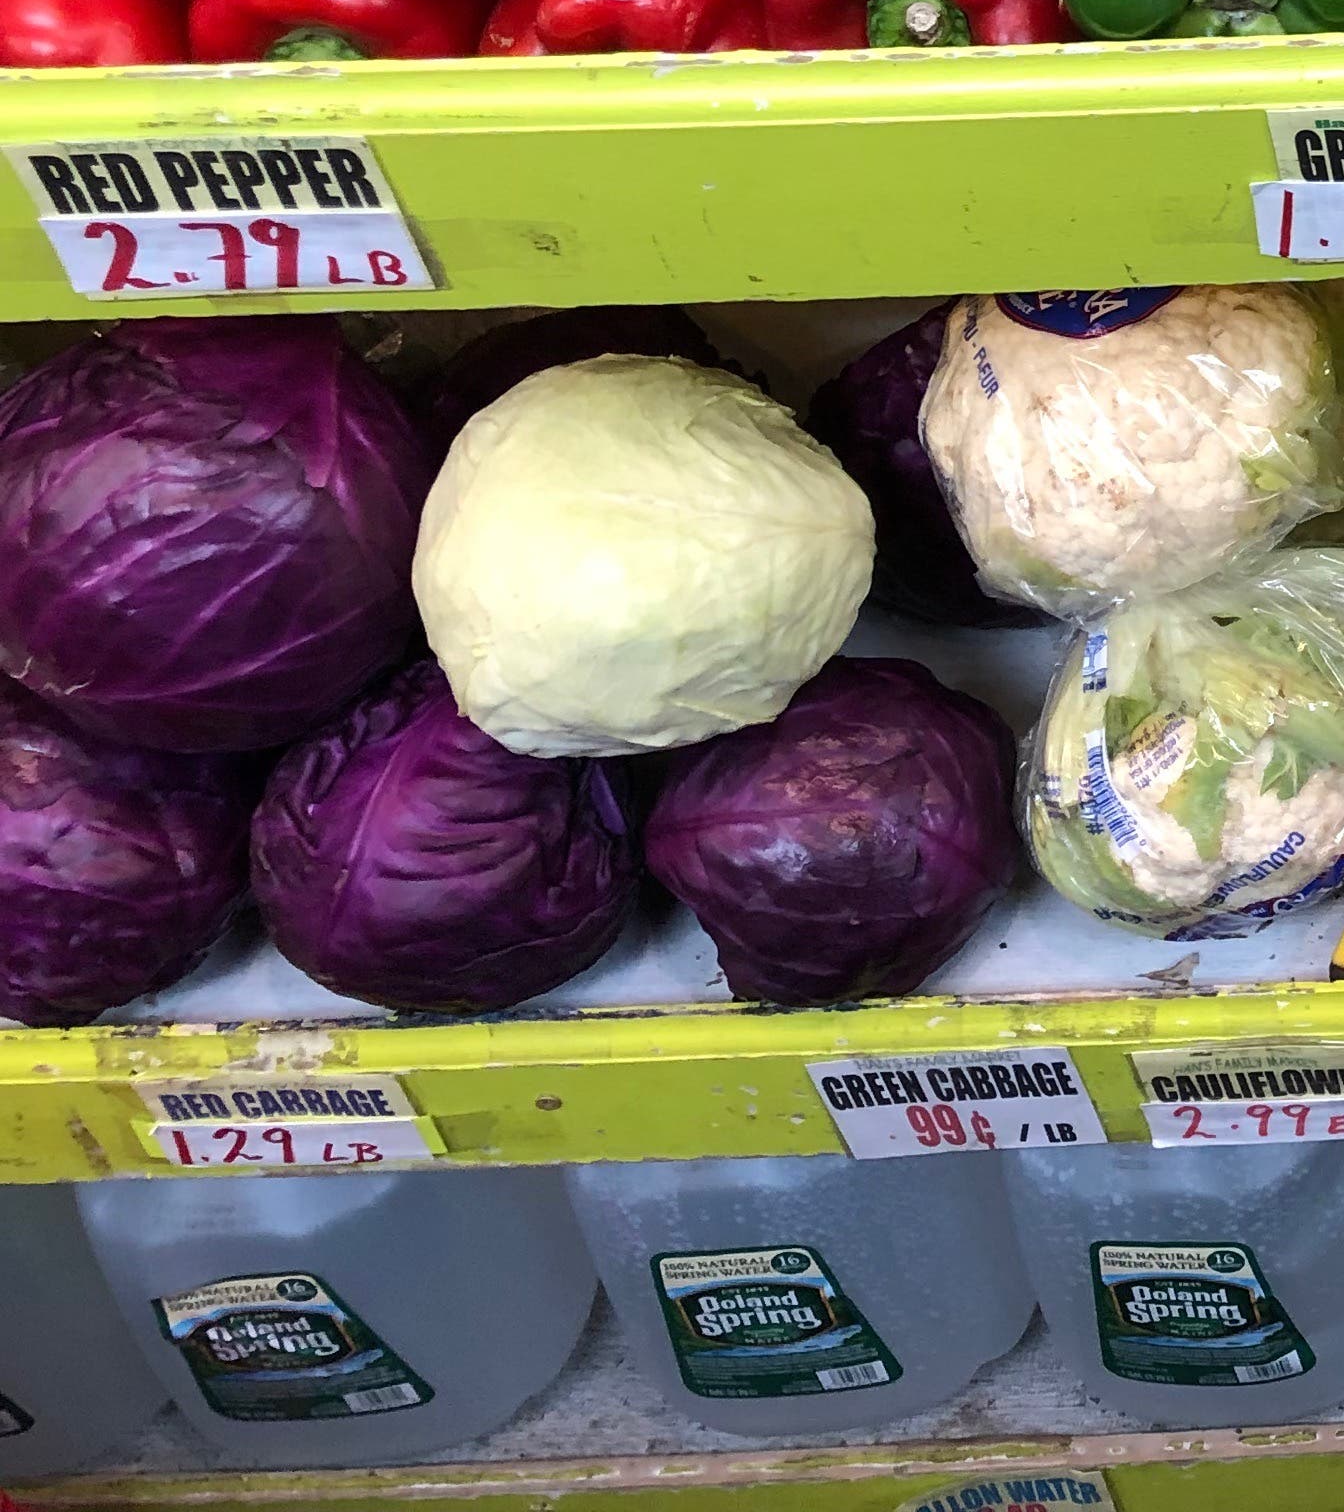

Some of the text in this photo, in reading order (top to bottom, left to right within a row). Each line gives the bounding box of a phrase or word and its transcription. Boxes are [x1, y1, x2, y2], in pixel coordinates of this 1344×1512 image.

[28, 149, 382, 214] RED PEPPER
[83, 218, 408, 291] 2.79 LB
[821, 1061, 1078, 1111] GREEN CABBAGE
[158, 1088, 395, 1121] RED CABBAGE
[1173, 1104, 1311, 1139] 2.99
[172, 1127, 384, 1165] 1.29 LB
[697, 1257, 769, 1269] NATURAL
[1103, 1259, 1208, 1270] SPRING WATER
[1136, 1252, 1206, 1261] NATURAL
[1215, 1253, 1235, 1265] 16
[665, 1270, 717, 1280] SPRING
[698, 1290, 799, 1315] Poland
[1131, 1285, 1228, 1304] Poland
[695, 1306, 822, 1337] Spring
[1126, 1300, 1247, 1327] Spring
[1003, 1477, 1102, 1505] WATER
